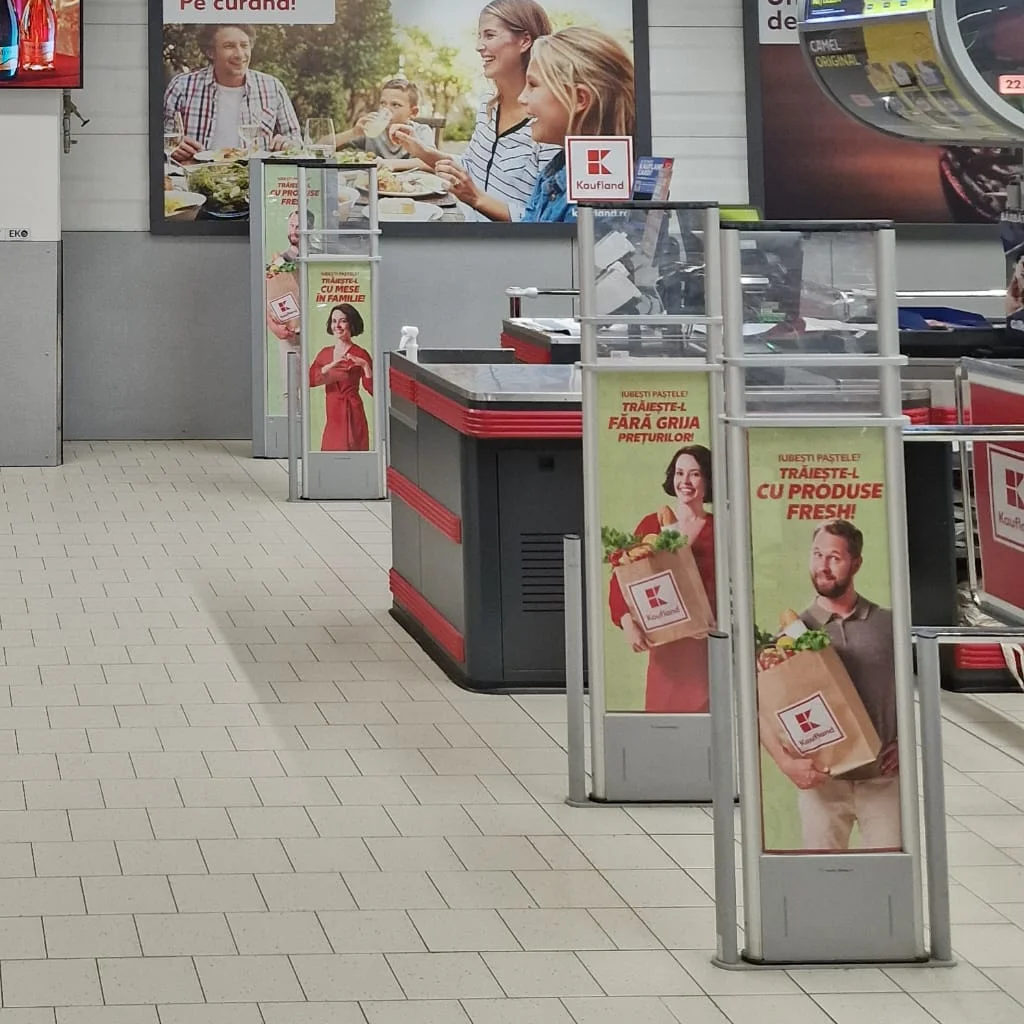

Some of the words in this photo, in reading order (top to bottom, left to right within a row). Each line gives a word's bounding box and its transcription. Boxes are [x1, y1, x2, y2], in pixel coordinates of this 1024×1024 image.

[809, 39, 842, 52] CAMEL
[816, 54, 862, 68] ORIGINAL
[576, 180, 624, 190] Kaufland
[334, 285, 360, 293] MESE
[327, 295, 366, 303] FAMILIE!
[622, 400, 687, 414] TRĂIEȘTE-L
[608, 413, 651, 430] FĂRĂ
[656, 416, 700, 430] GRIJA
[618, 433, 694, 445] PREȚURILOR!
[778, 454, 815, 463] IUBEȘTI
[779, 465, 859, 482] TRĂIEȘTE-L
[756, 483, 784, 499] CU
[788, 483, 884, 499] PRODUSE
[787, 504, 856, 520] FRESH!
